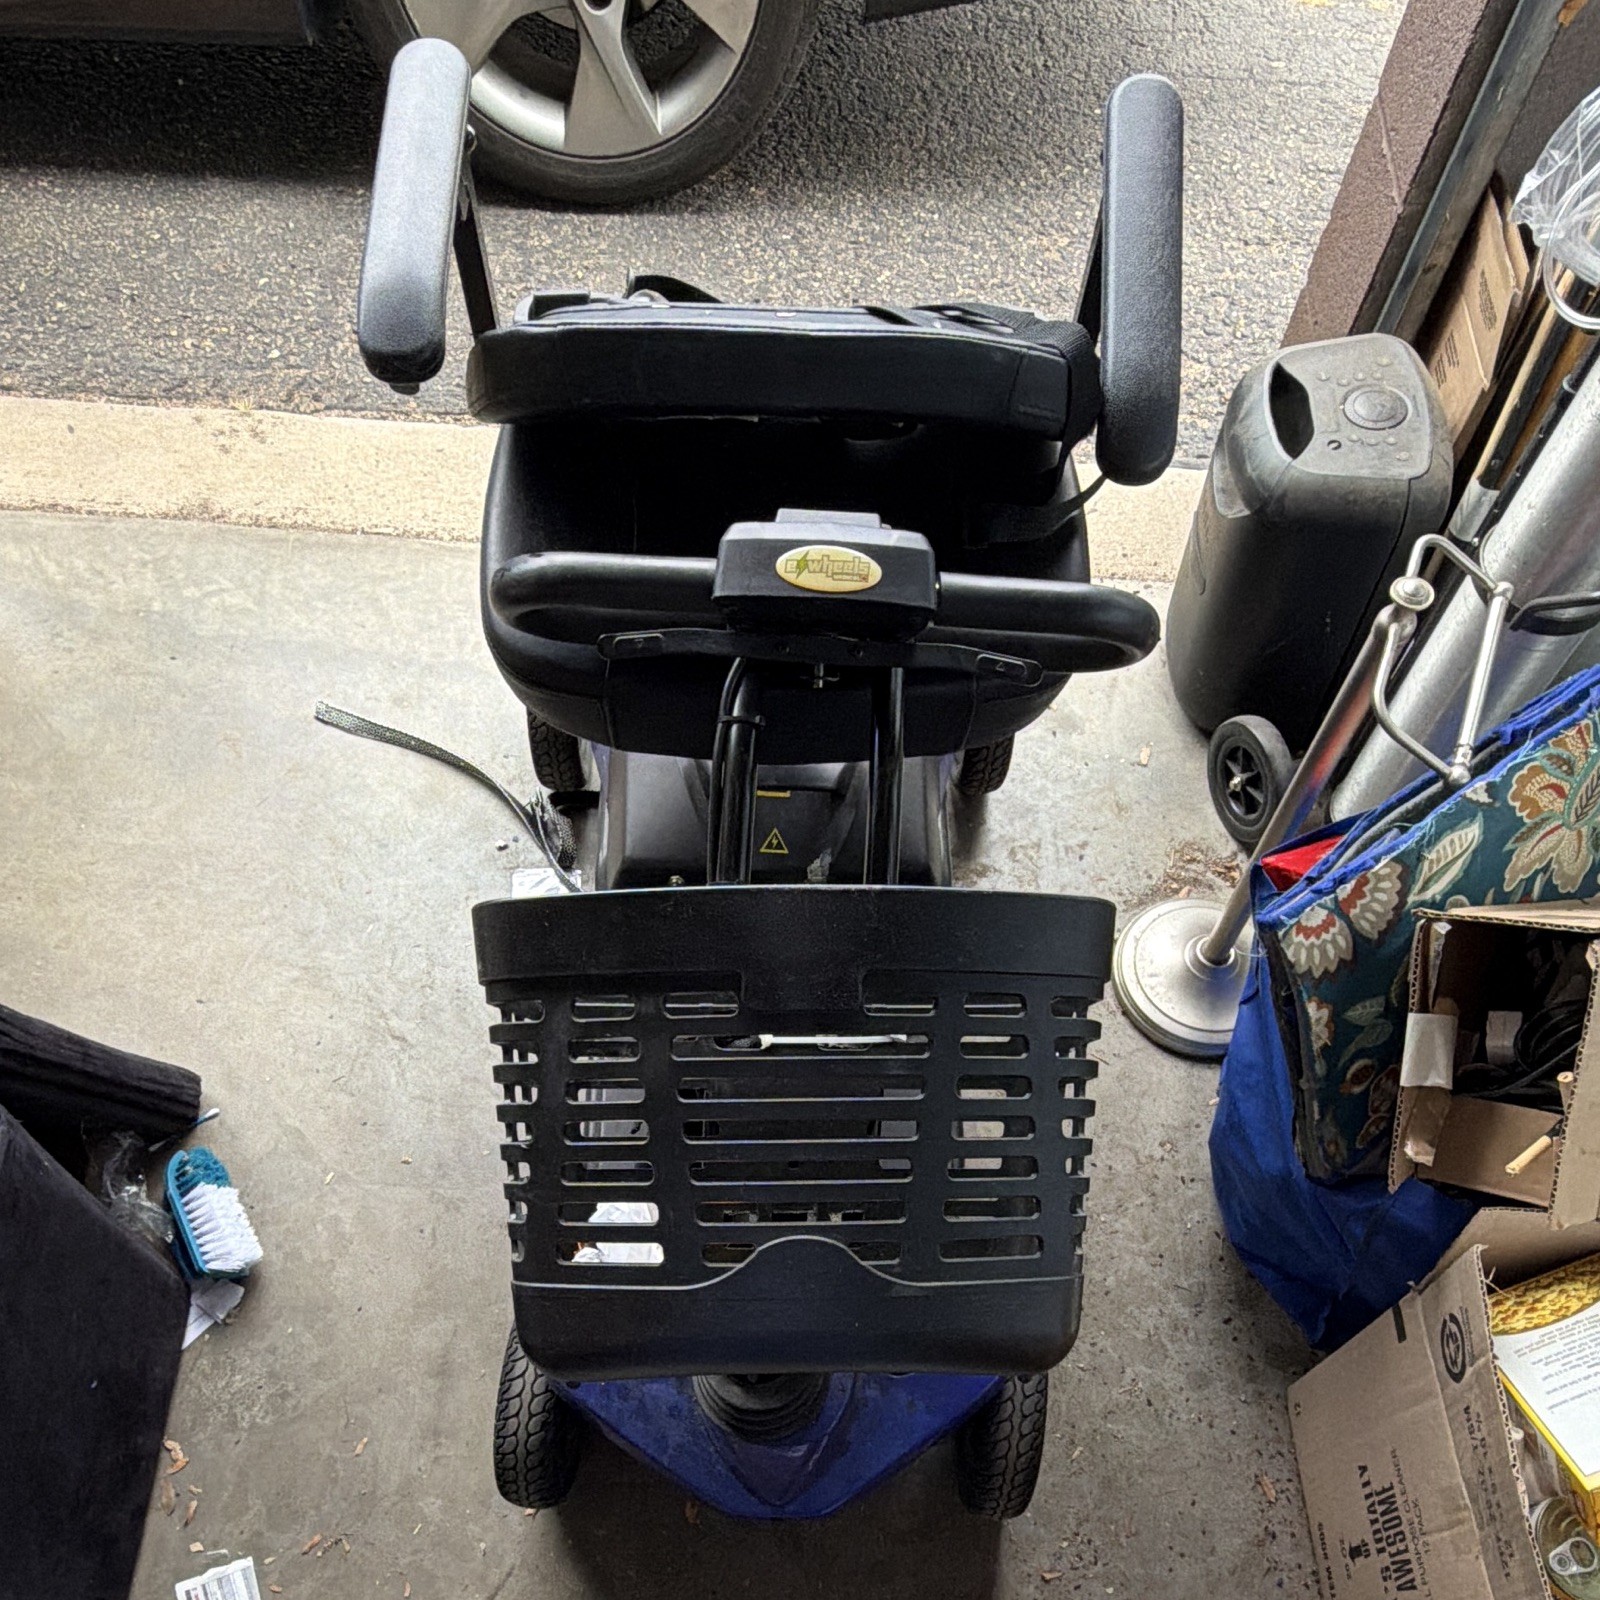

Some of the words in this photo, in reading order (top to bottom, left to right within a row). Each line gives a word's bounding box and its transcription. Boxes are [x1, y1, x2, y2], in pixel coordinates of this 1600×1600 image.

[1358, 1464, 1387, 1557] TOTALLY
[1390, 1448, 1411, 1513] CLEANER
[1361, 1538, 1371, 1559] UP
[1374, 1481, 1418, 1591] AWESOME
[1411, 1497, 1427, 1536] PACK
[1422, 1540, 1431, 1555] 12
[1407, 1517, 1429, 1586] PURPOSE
